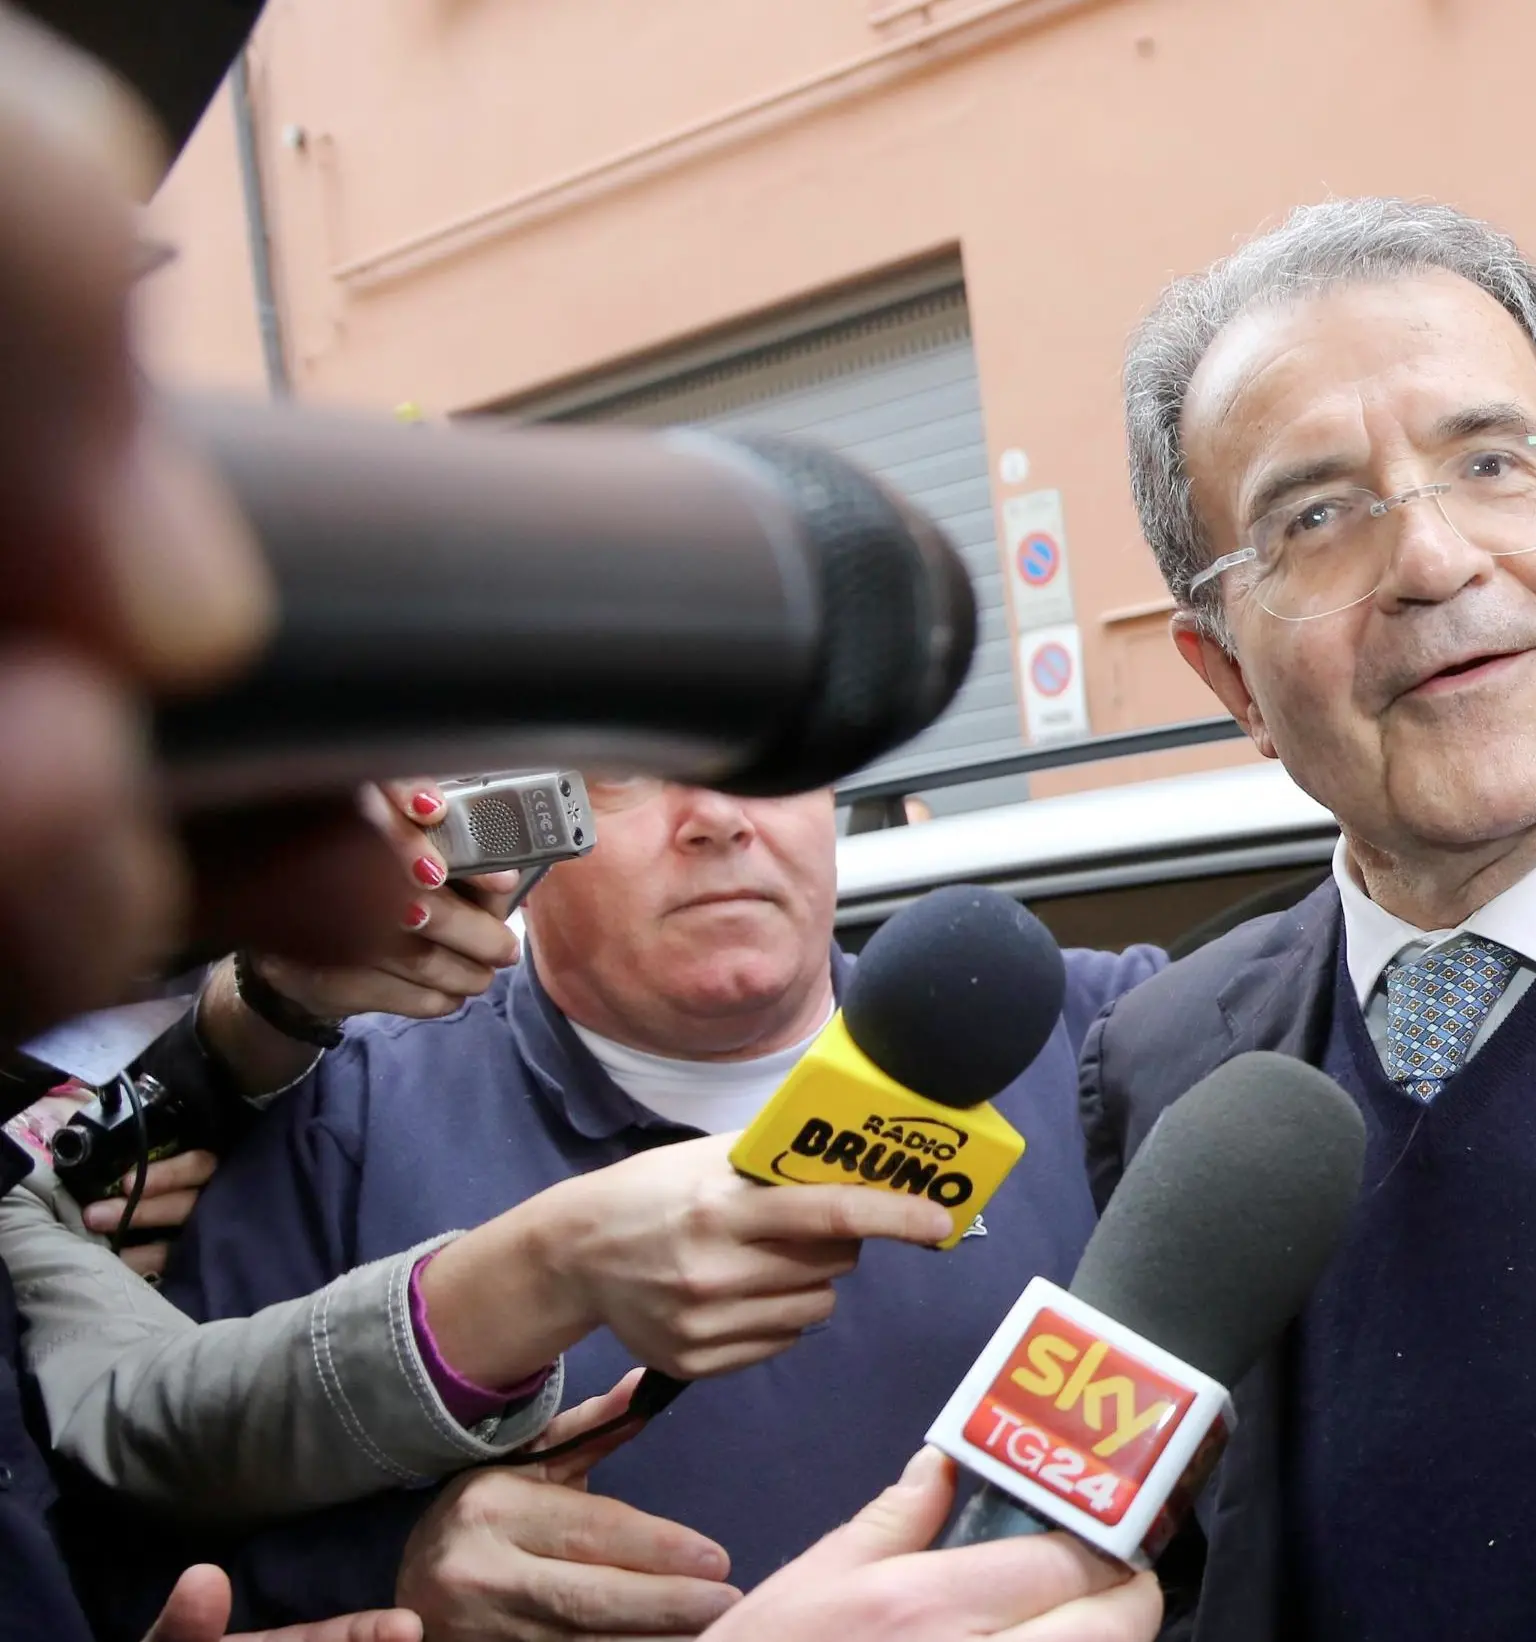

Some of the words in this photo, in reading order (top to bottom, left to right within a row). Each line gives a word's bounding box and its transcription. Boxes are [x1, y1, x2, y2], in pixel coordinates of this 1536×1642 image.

[790, 1117, 974, 1208] BRUNO
[863, 1114, 957, 1162] RADIO
[1010, 1333, 1170, 1457] sky
[986, 1405, 1122, 1511] TG24
